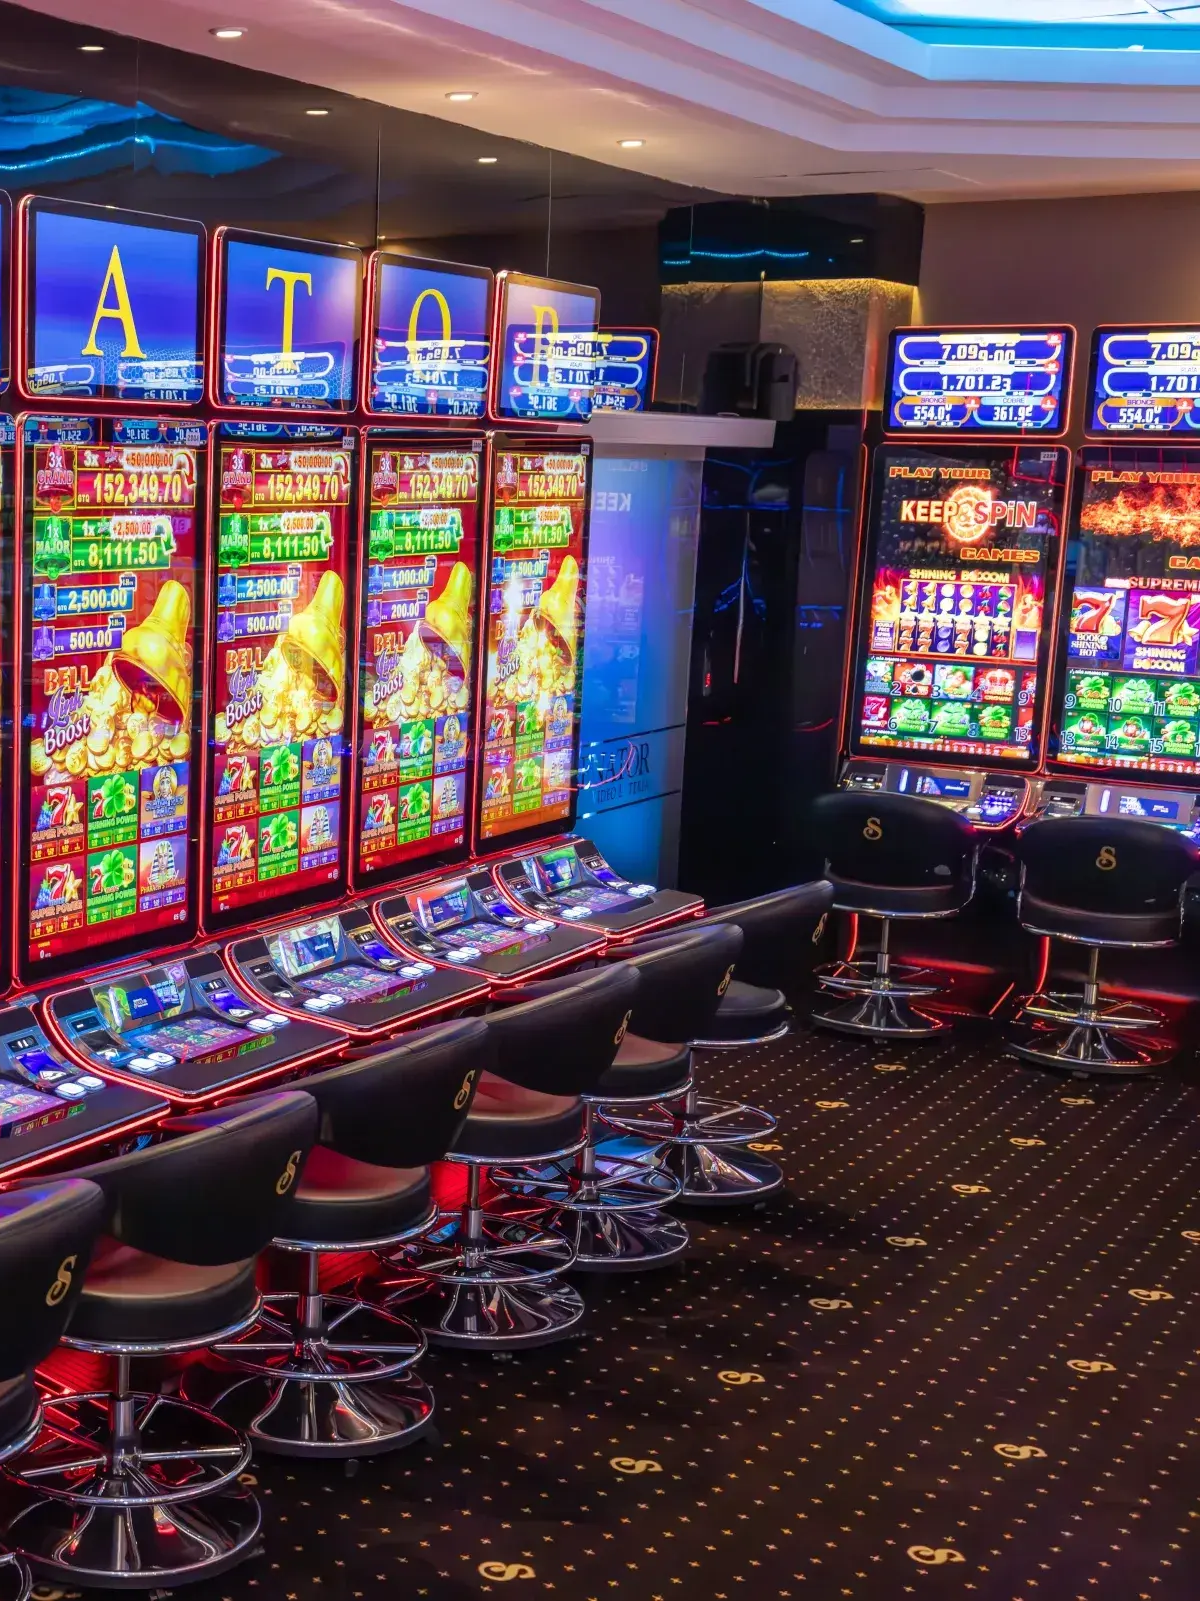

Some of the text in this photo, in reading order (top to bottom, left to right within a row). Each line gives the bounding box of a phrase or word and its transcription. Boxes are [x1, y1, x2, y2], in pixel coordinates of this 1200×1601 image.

[81, 244, 147, 359] A
[266, 266, 313, 370] T
[48, 451, 63, 467] 3x
[84, 450, 99, 467] 3x
[36, 470, 74, 486] GRAND
[889, 466, 992, 480] PLAY YOUR
[1091, 471, 1143, 482] PLAY
[93, 473, 182, 507] 152,349.70
[268, 474, 339, 504] 152,349.70
[409, 473, 469, 501] 152,349.70
[527, 474, 578, 499] 152,349.70
[35, 540, 70, 555] MAJOR
[263, 535, 319, 560] 8,111.50
[405, 530, 451, 553] 8,111.50
[88, 541, 158, 568] 8,111.50
[960, 547, 1040, 563] GAMES
[392, 569, 429, 588] 1,000.00
[909, 568, 957, 581] SHINING
[246, 577, 294, 599] 2,500.00
[68, 588, 128, 613] 2,500.00
[391, 601, 420, 619] 200.00
[247, 614, 281, 632] 500.00
[69, 629, 113, 650] 500.00
[373, 630, 405, 657] BELL
[226, 646, 264, 673] BELL
[1135, 647, 1186, 659] SHINING
[43, 665, 90, 696] BELL
[373, 672, 403, 706] Boost
[891, 681, 902, 696] 2
[931, 685, 941, 698] 3
[1018, 691, 1029, 705] 9
[1065, 693, 1076, 709] 9
[226, 690, 263, 728] Boost
[888, 717, 897, 730] 6
[44, 714, 90, 755] Boost
[1014, 727, 1028, 742] 13
[1061, 731, 1075, 745] 13
